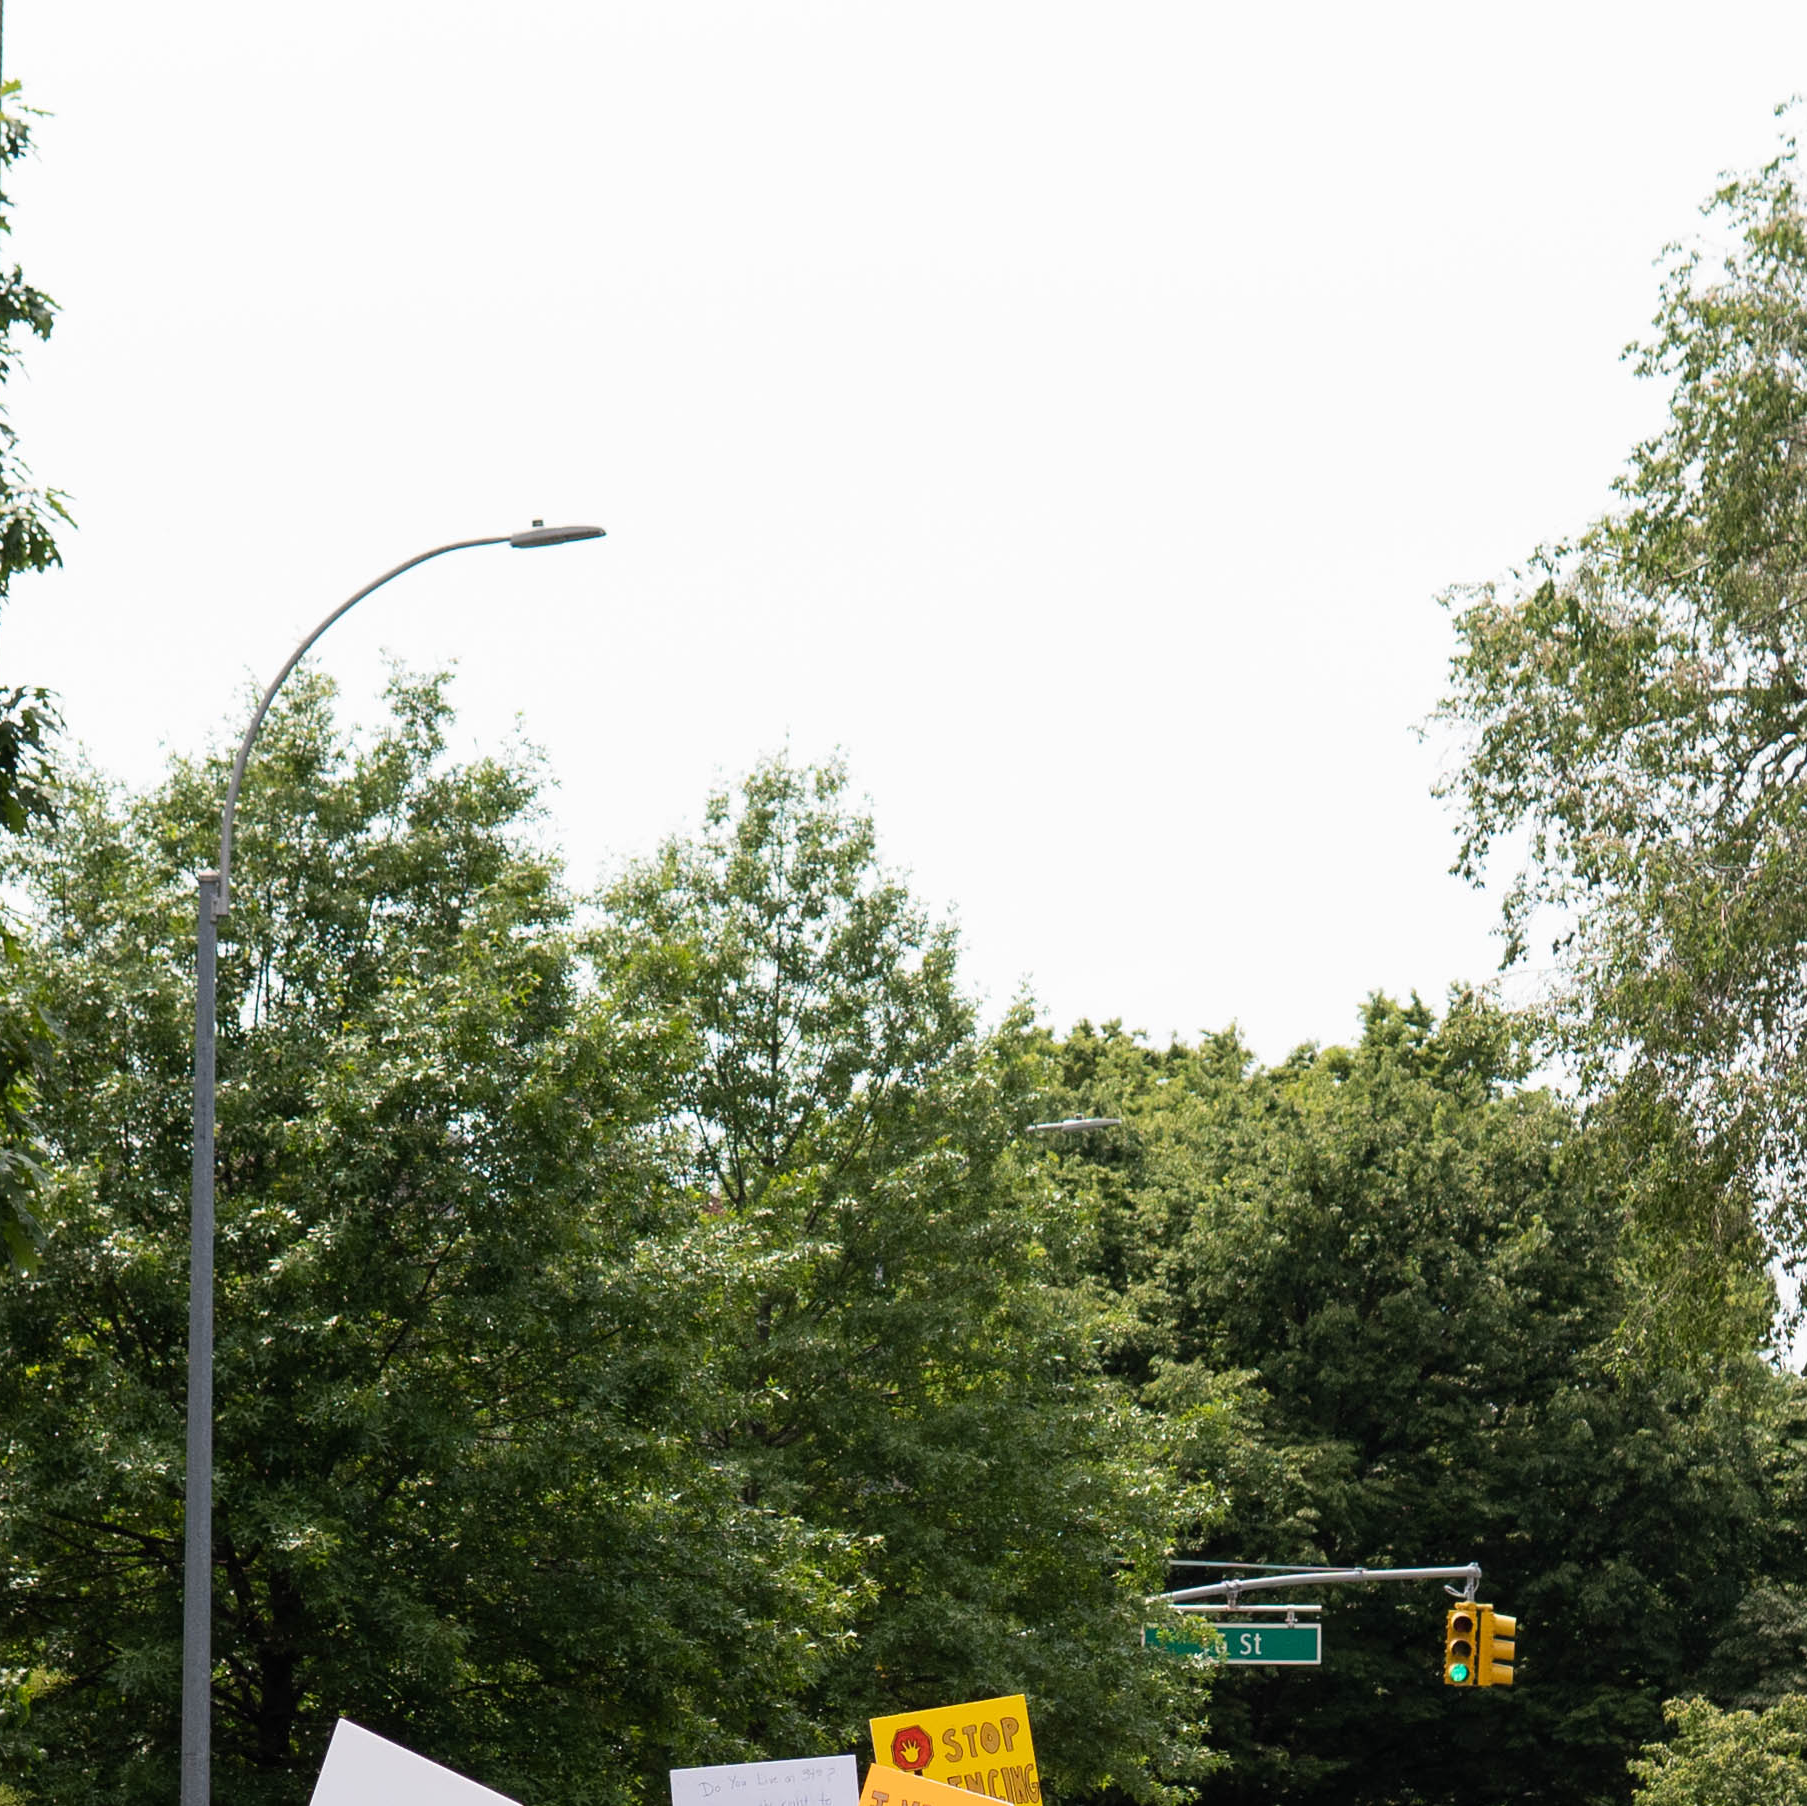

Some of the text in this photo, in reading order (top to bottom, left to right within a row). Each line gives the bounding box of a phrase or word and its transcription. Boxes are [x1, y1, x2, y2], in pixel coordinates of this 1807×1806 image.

[1239, 1633, 1262, 1655] St
[942, 1716, 1019, 1763] STOP
[699, 1782, 721, 1797] Do
[729, 1776, 747, 1791] You
[819, 1792, 833, 1806] to
